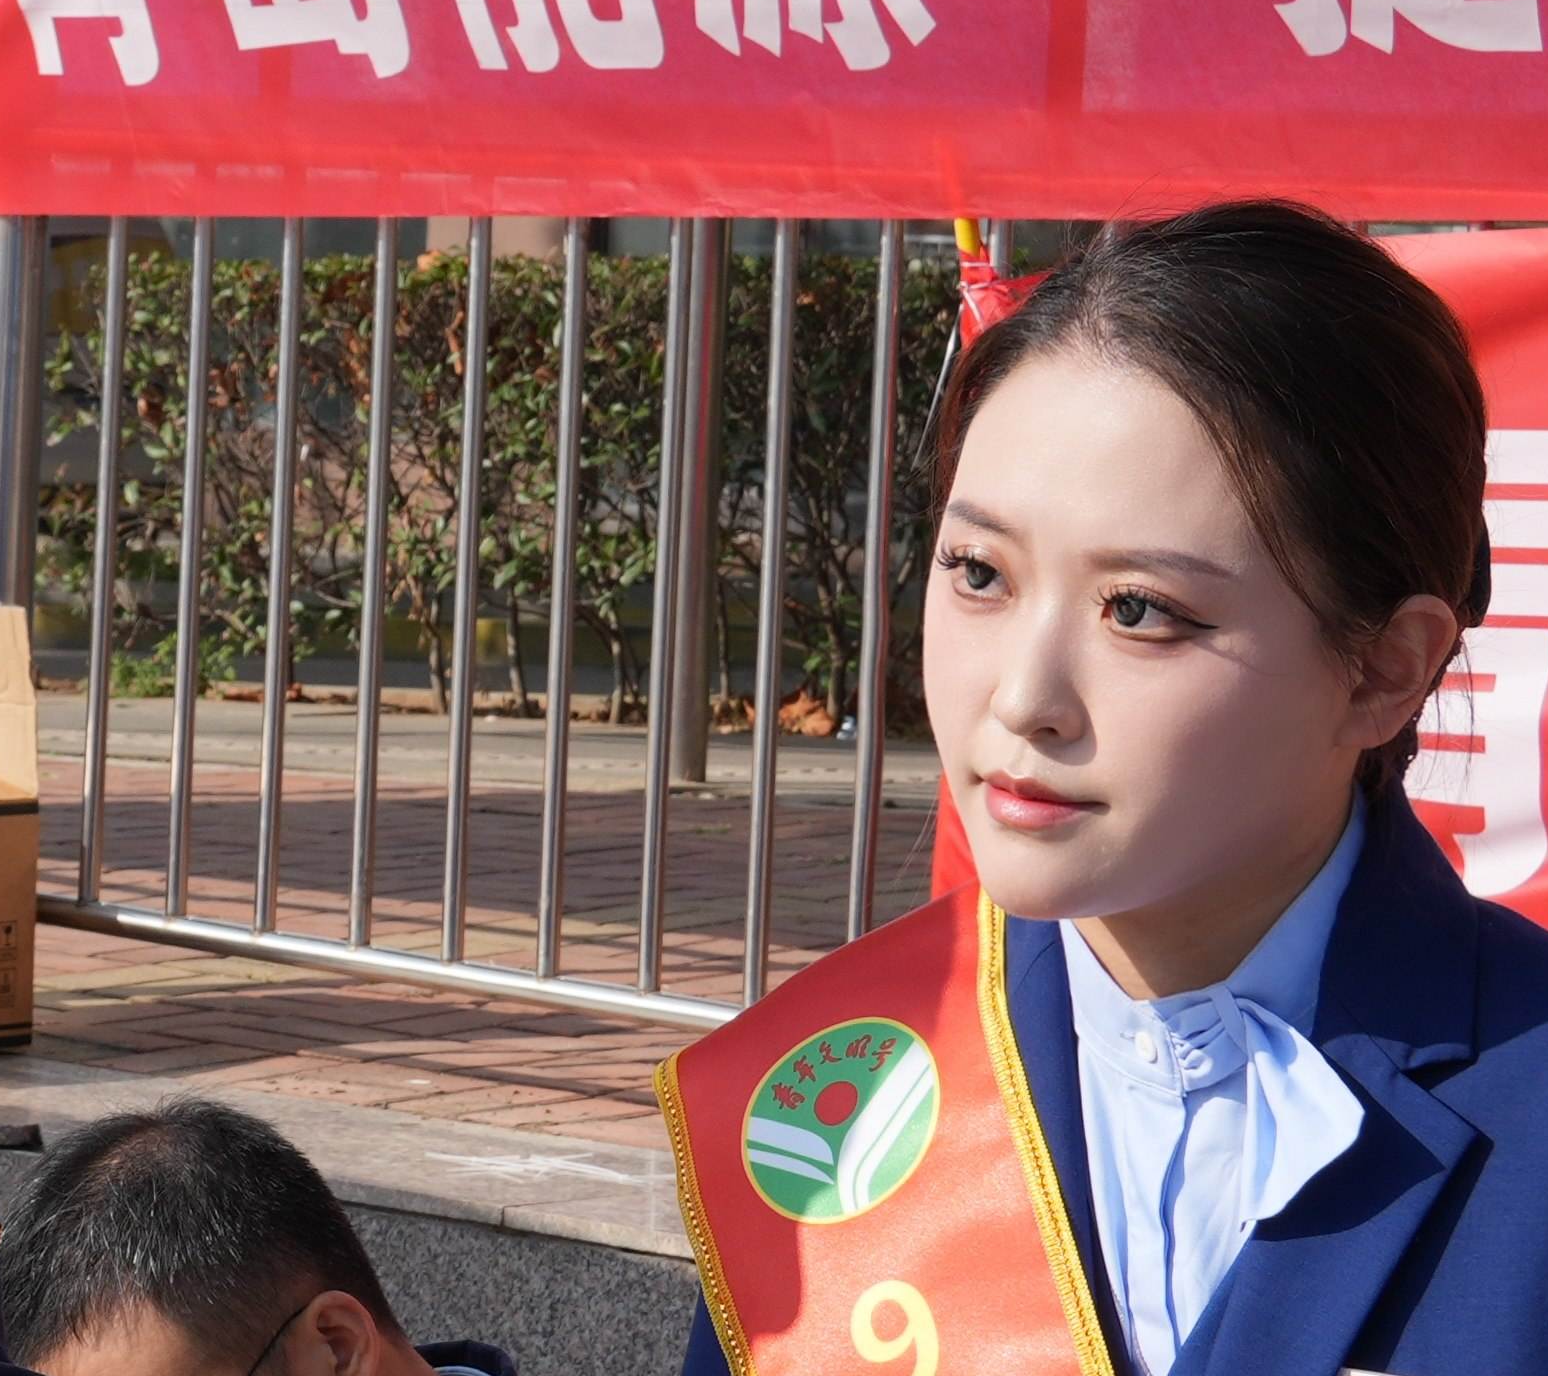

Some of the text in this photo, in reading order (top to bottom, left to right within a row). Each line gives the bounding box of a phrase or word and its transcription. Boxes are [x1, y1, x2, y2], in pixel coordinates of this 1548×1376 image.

[771, 1034, 897, 1111] 青年文明号
